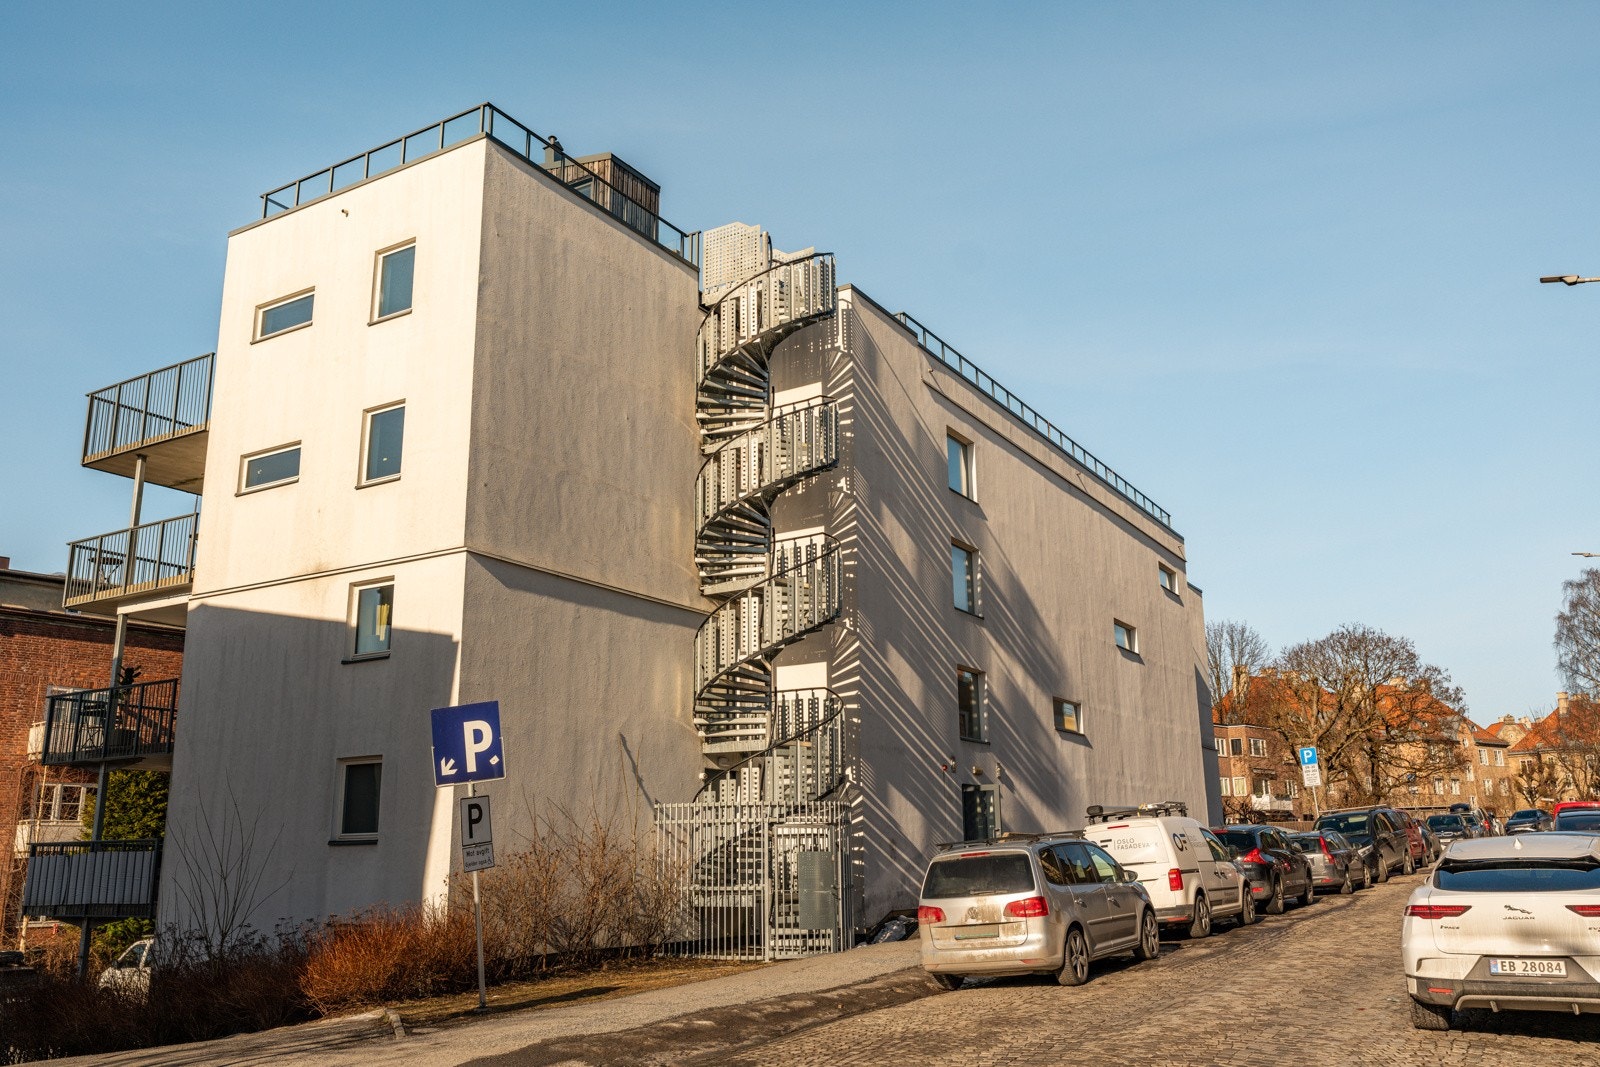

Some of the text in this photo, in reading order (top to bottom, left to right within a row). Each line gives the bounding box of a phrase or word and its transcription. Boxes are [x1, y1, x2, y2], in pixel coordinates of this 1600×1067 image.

[464, 720, 493, 773] P
[1304, 750, 1313, 763] P
[468, 803, 483, 839] P
[1116, 837, 1135, 845] OSLO
[476, 848, 490, 857] avgift
[1500, 961, 1516, 972] EB
[1521, 961, 1562, 973] 28084
